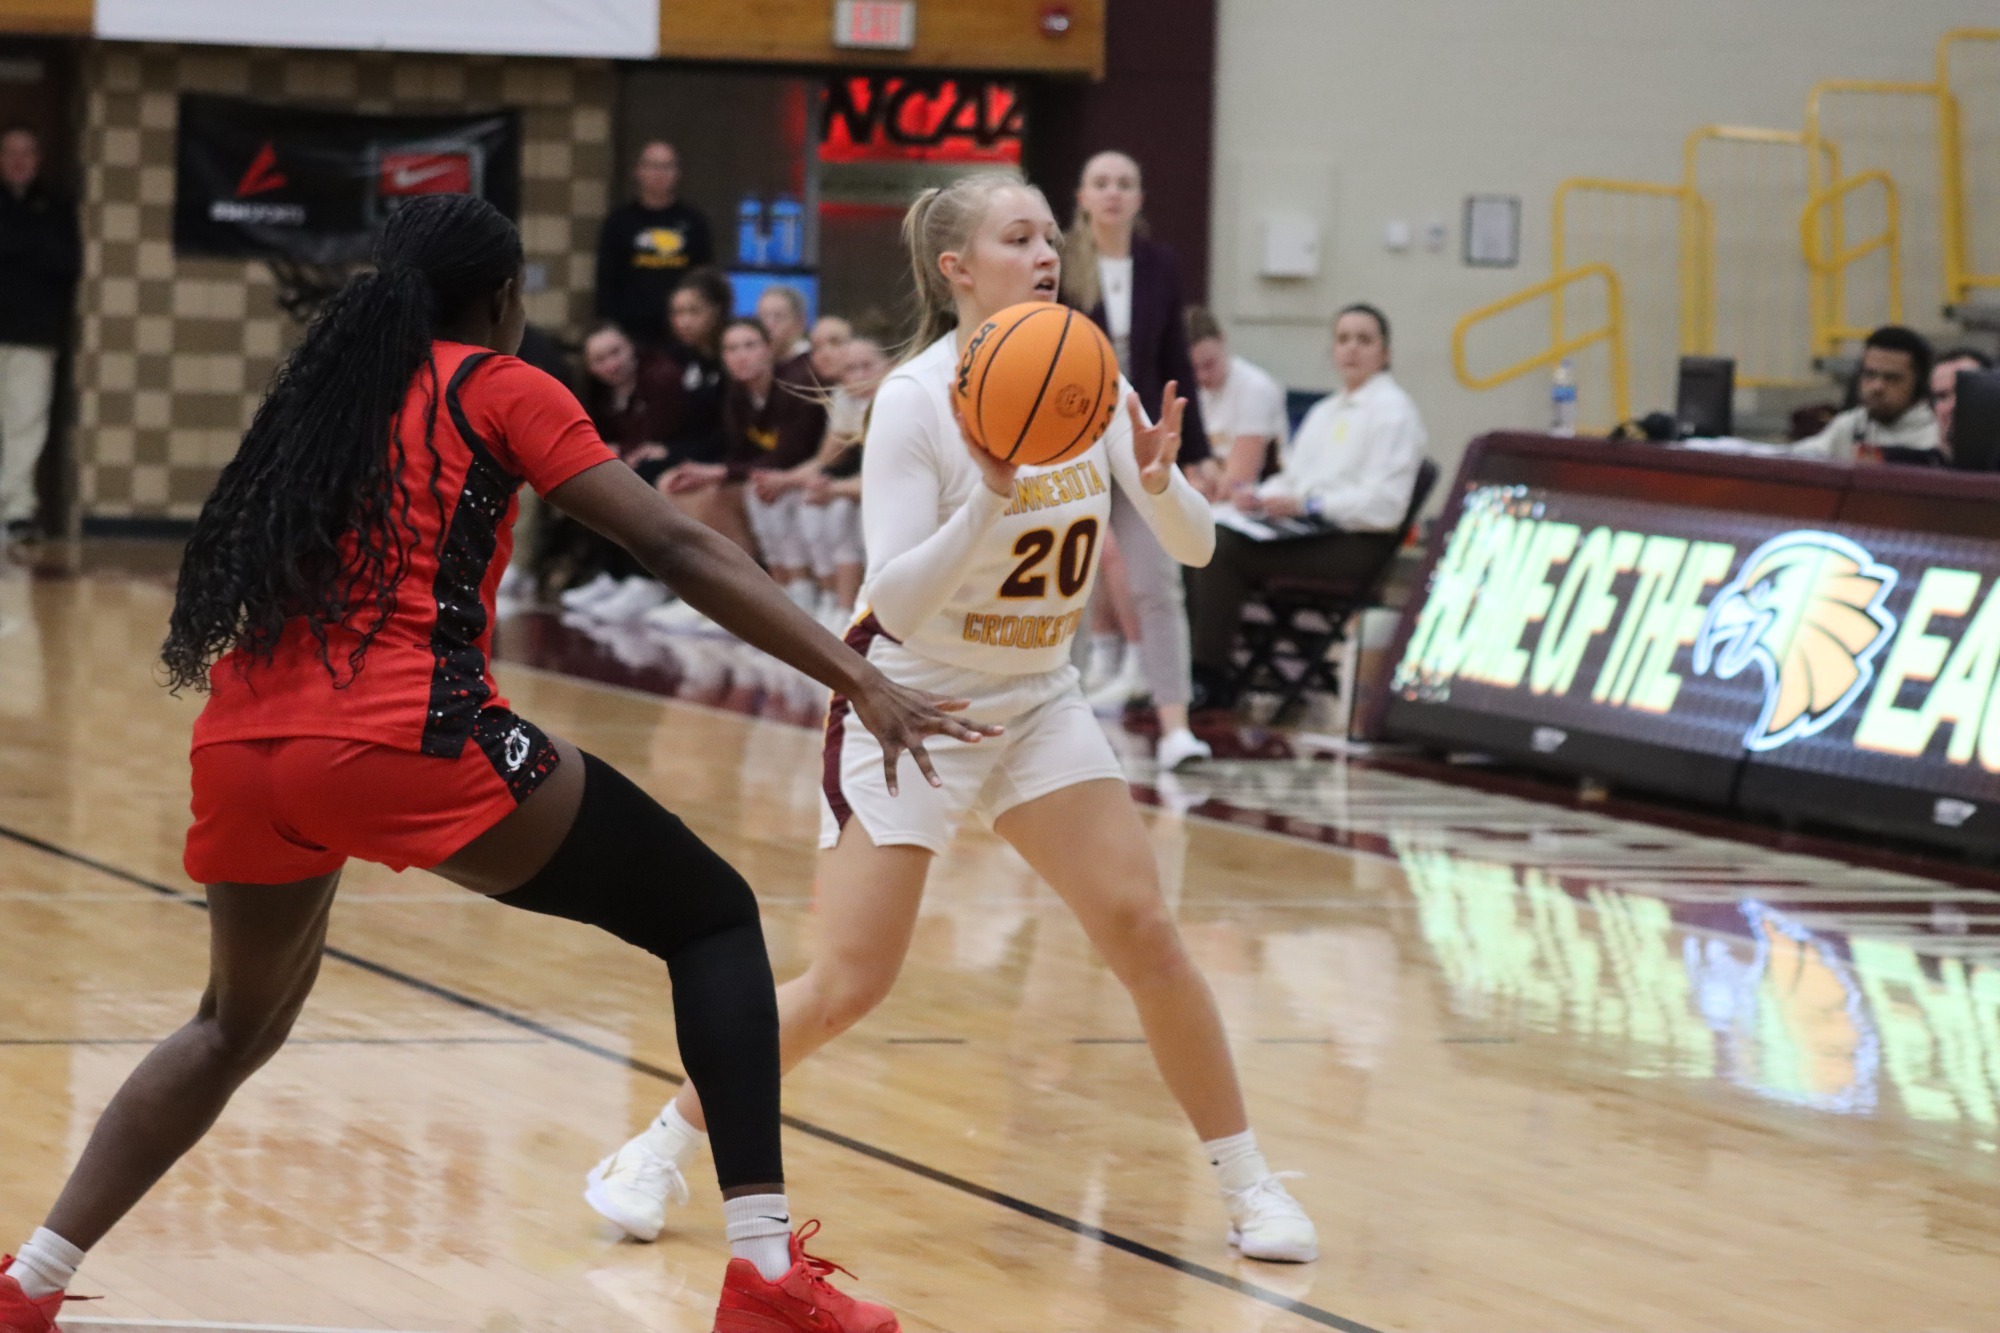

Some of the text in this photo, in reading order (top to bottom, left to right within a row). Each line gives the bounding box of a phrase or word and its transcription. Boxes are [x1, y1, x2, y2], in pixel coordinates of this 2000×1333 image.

[958, 323, 996, 398] NCAA
[997, 514, 1099, 600] 20
[1530, 526, 1645, 697] OF
[1591, 535, 1736, 715] THE
